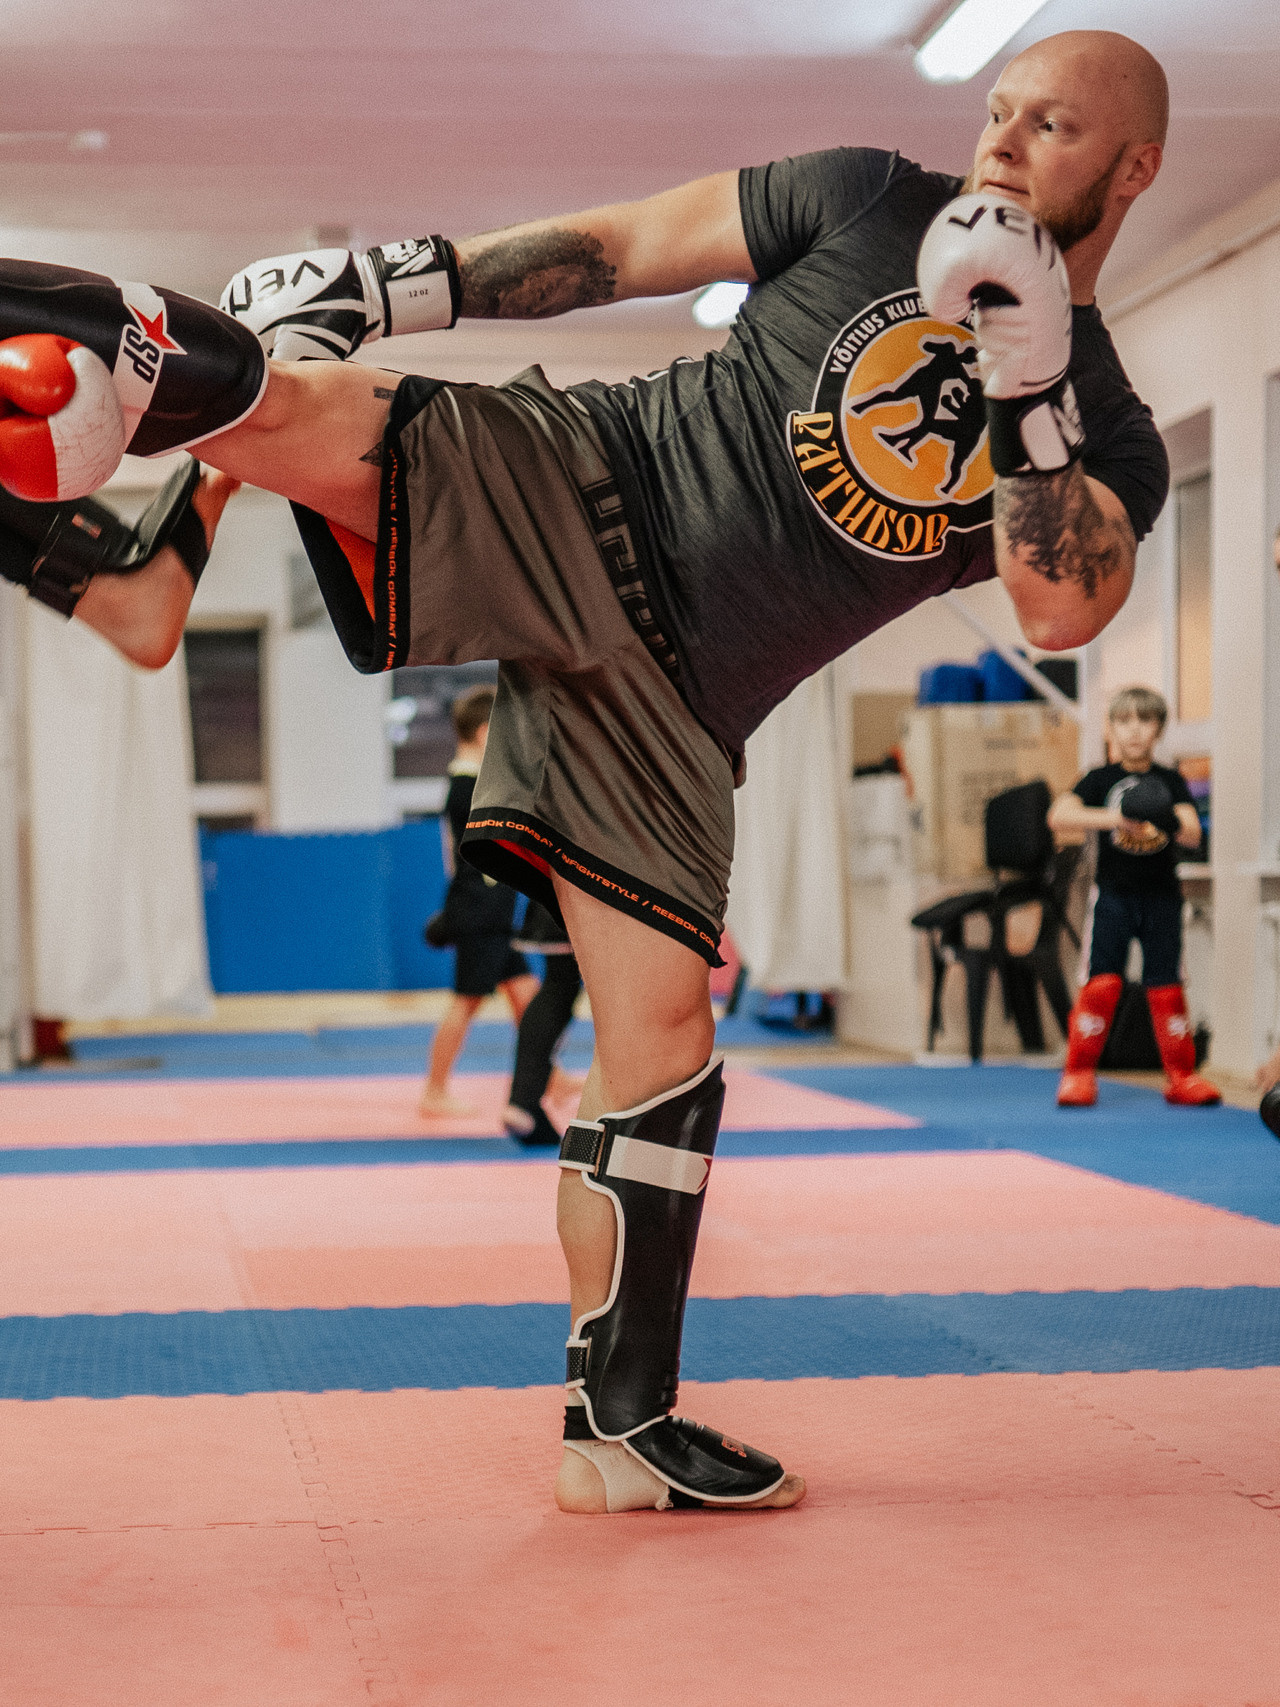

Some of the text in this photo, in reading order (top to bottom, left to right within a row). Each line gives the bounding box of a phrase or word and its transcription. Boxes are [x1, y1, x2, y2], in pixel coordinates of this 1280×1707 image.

[123, 328, 160, 384] SP
[830, 316, 886, 374] VÕITLUS
[884, 297, 929, 321] KLUB
[388, 526, 399, 578] REEBOK
[387, 580, 397, 640] COMBAT
[505, 820, 554, 848] COMBAT
[651, 903, 700, 936] REEBOK
